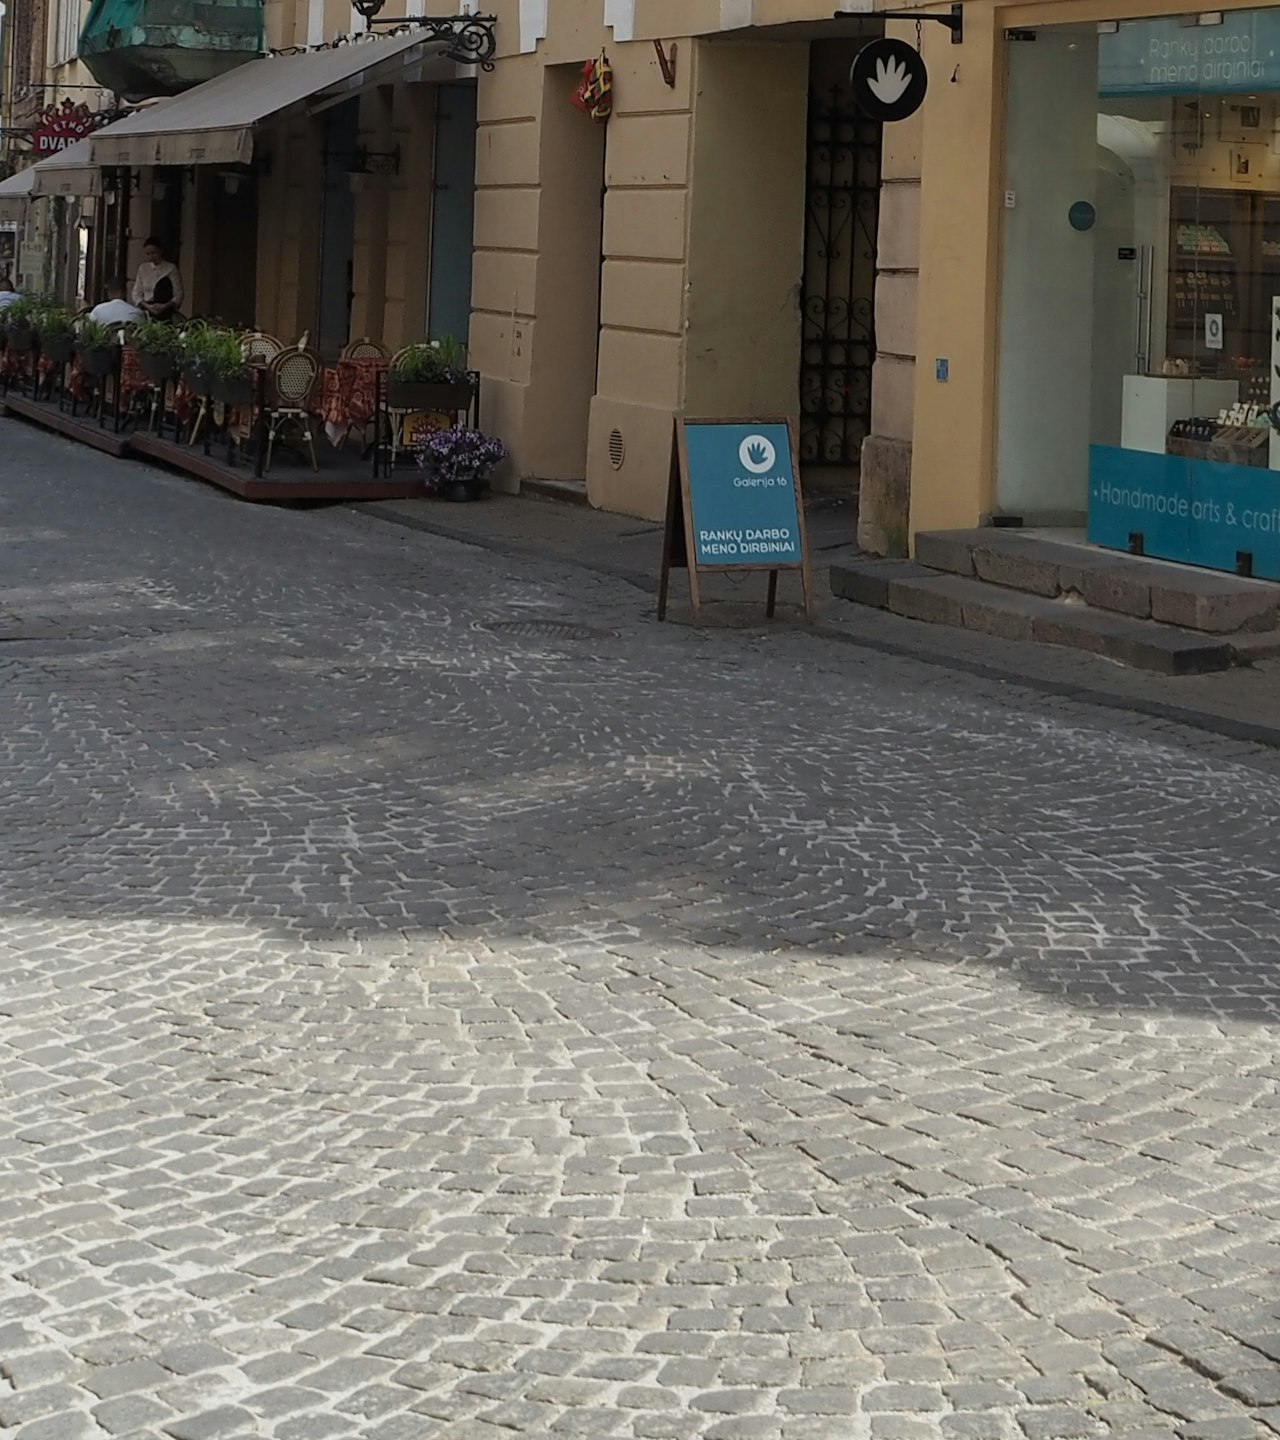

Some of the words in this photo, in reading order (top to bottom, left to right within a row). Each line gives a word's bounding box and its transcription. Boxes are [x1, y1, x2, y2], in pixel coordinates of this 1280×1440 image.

[53, 121, 84, 133] ETNO
[733, 477, 774, 488] Galerija
[776, 477, 787, 486] 16
[1100, 480, 1188, 517] Handmade
[1192, 499, 1220, 523] arts
[1225, 502, 1237, 525] &
[700, 529, 742, 543] RANKŲ
[746, 528, 789, 540] DARBO
[701, 543, 737, 555] MENO
[740, 542, 795, 554] DIRBINIAI
